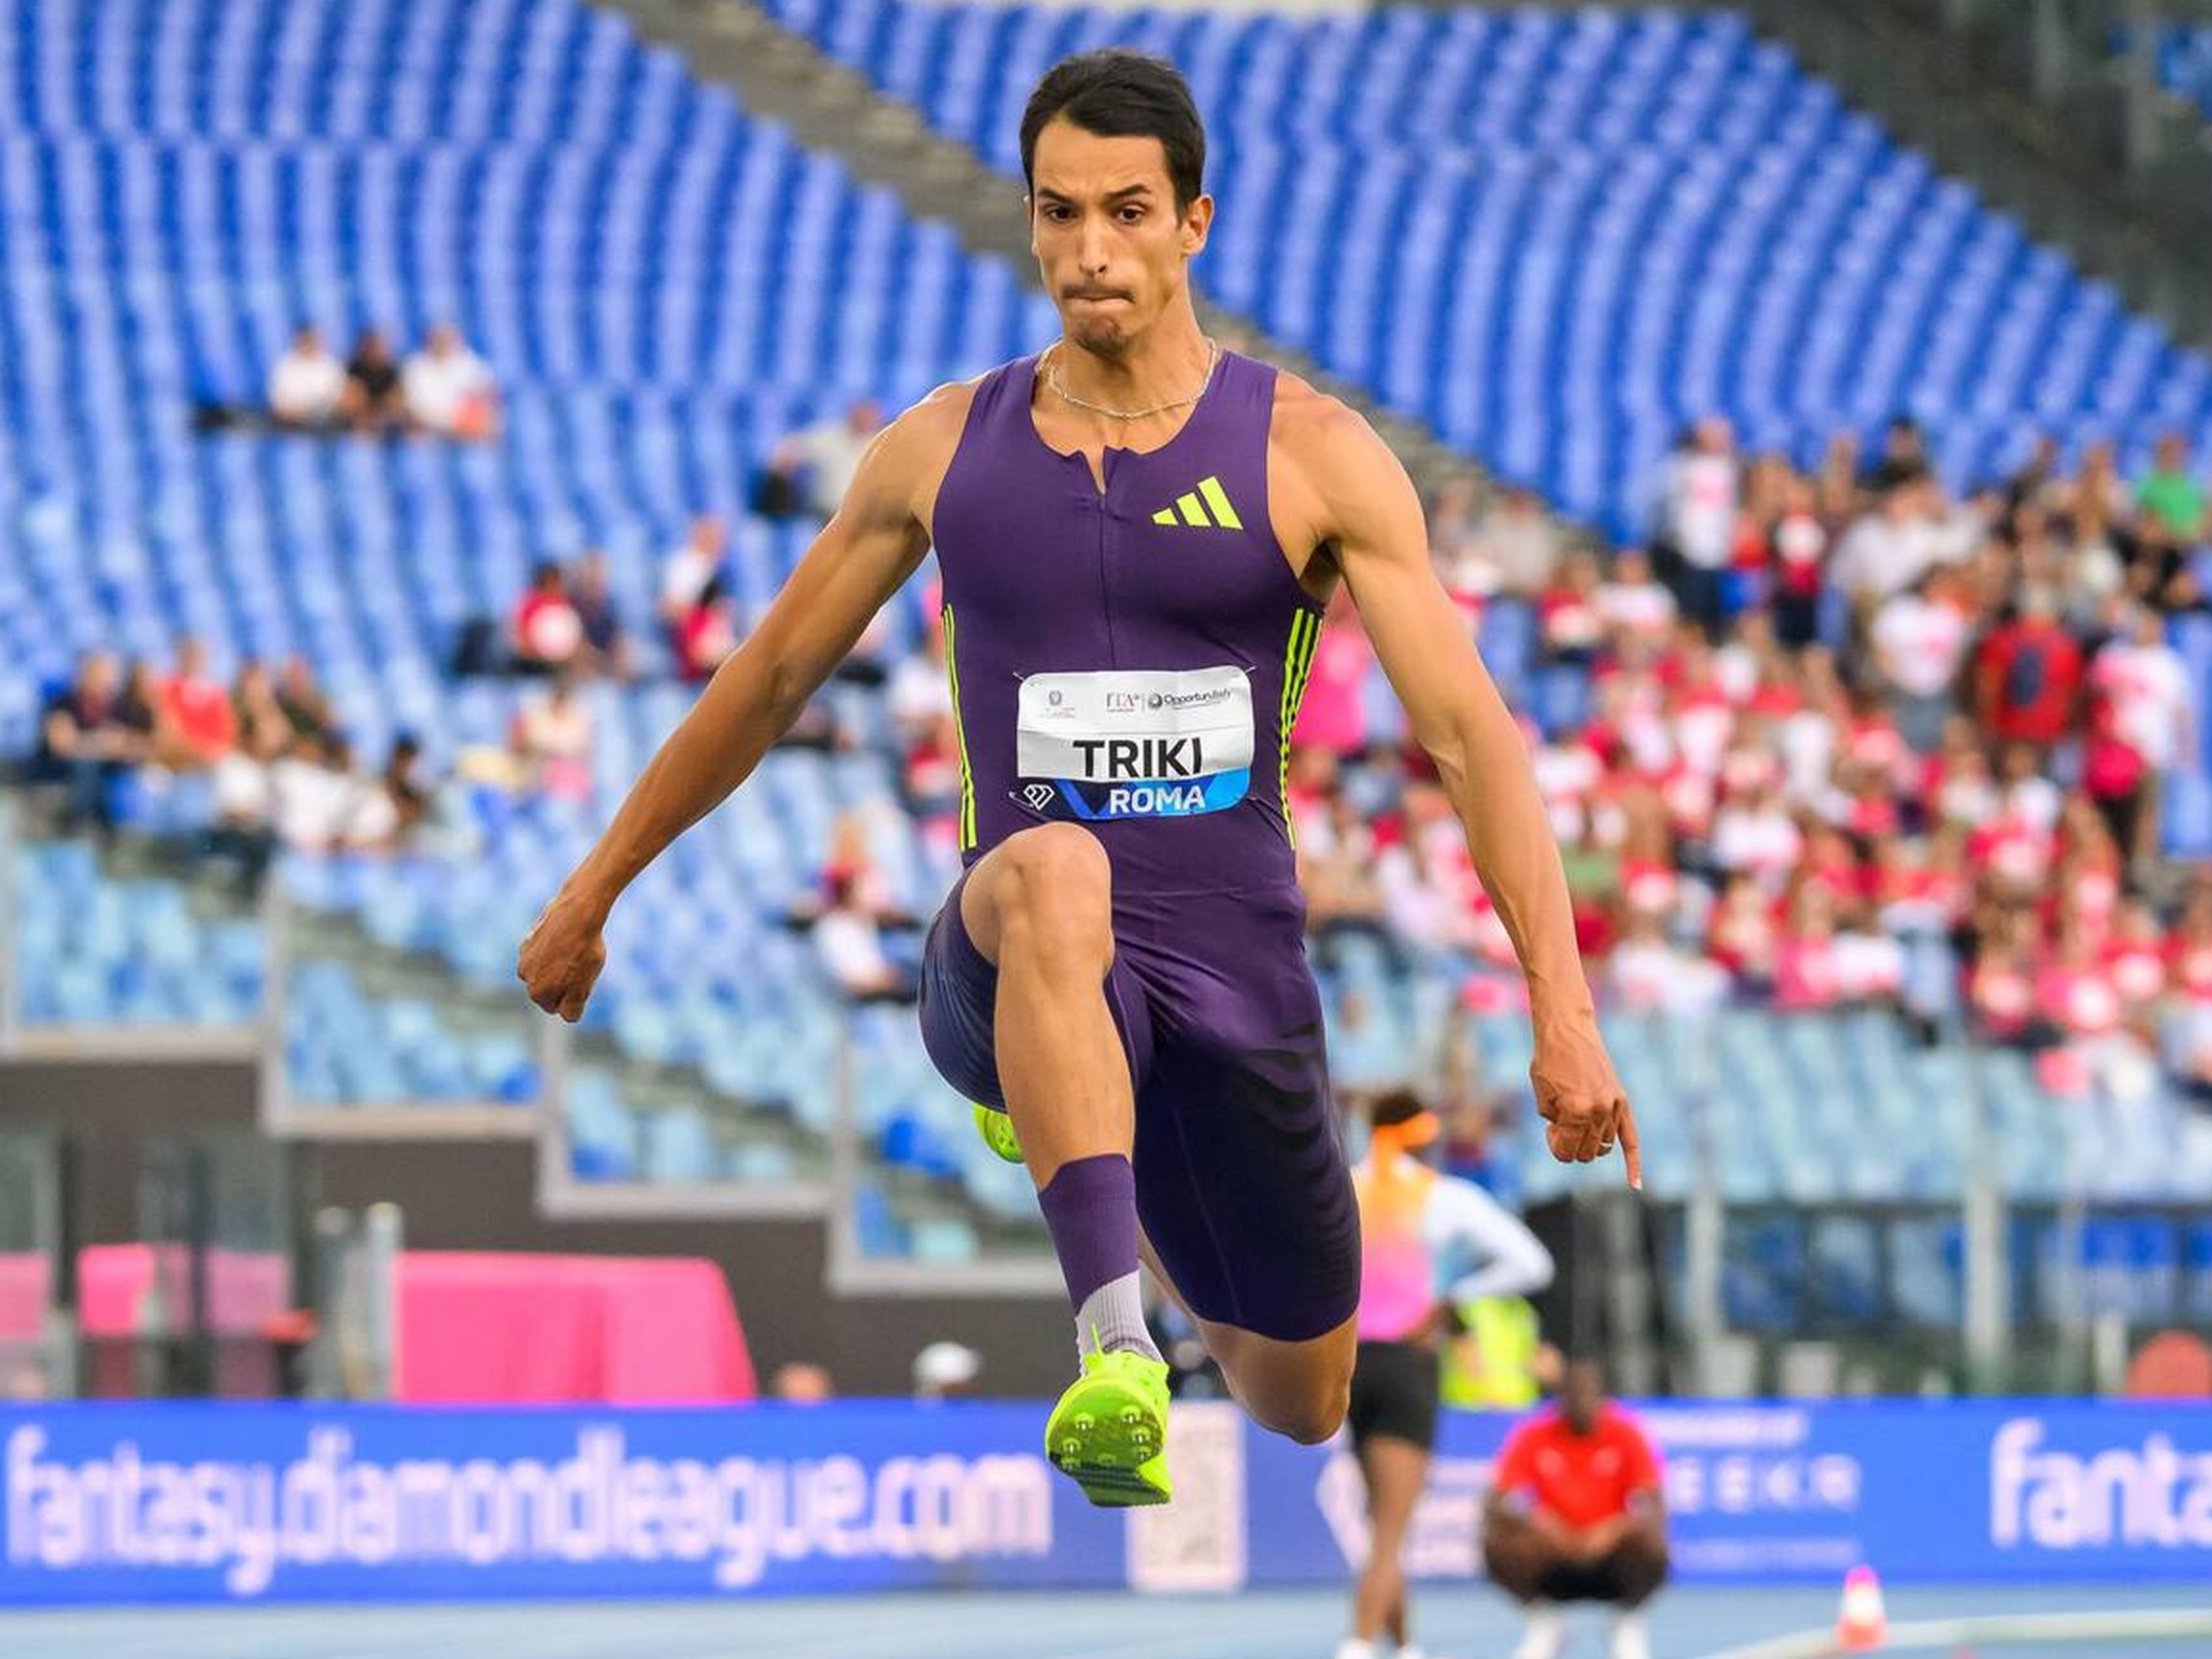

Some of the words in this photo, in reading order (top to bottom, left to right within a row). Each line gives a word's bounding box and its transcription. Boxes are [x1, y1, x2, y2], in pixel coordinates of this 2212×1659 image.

[1072, 737, 1203, 779] TRIKI
[1110, 785, 1207, 815] ROMA
[6, 1424, 1052, 1596] fantasy.diamondleague.com
